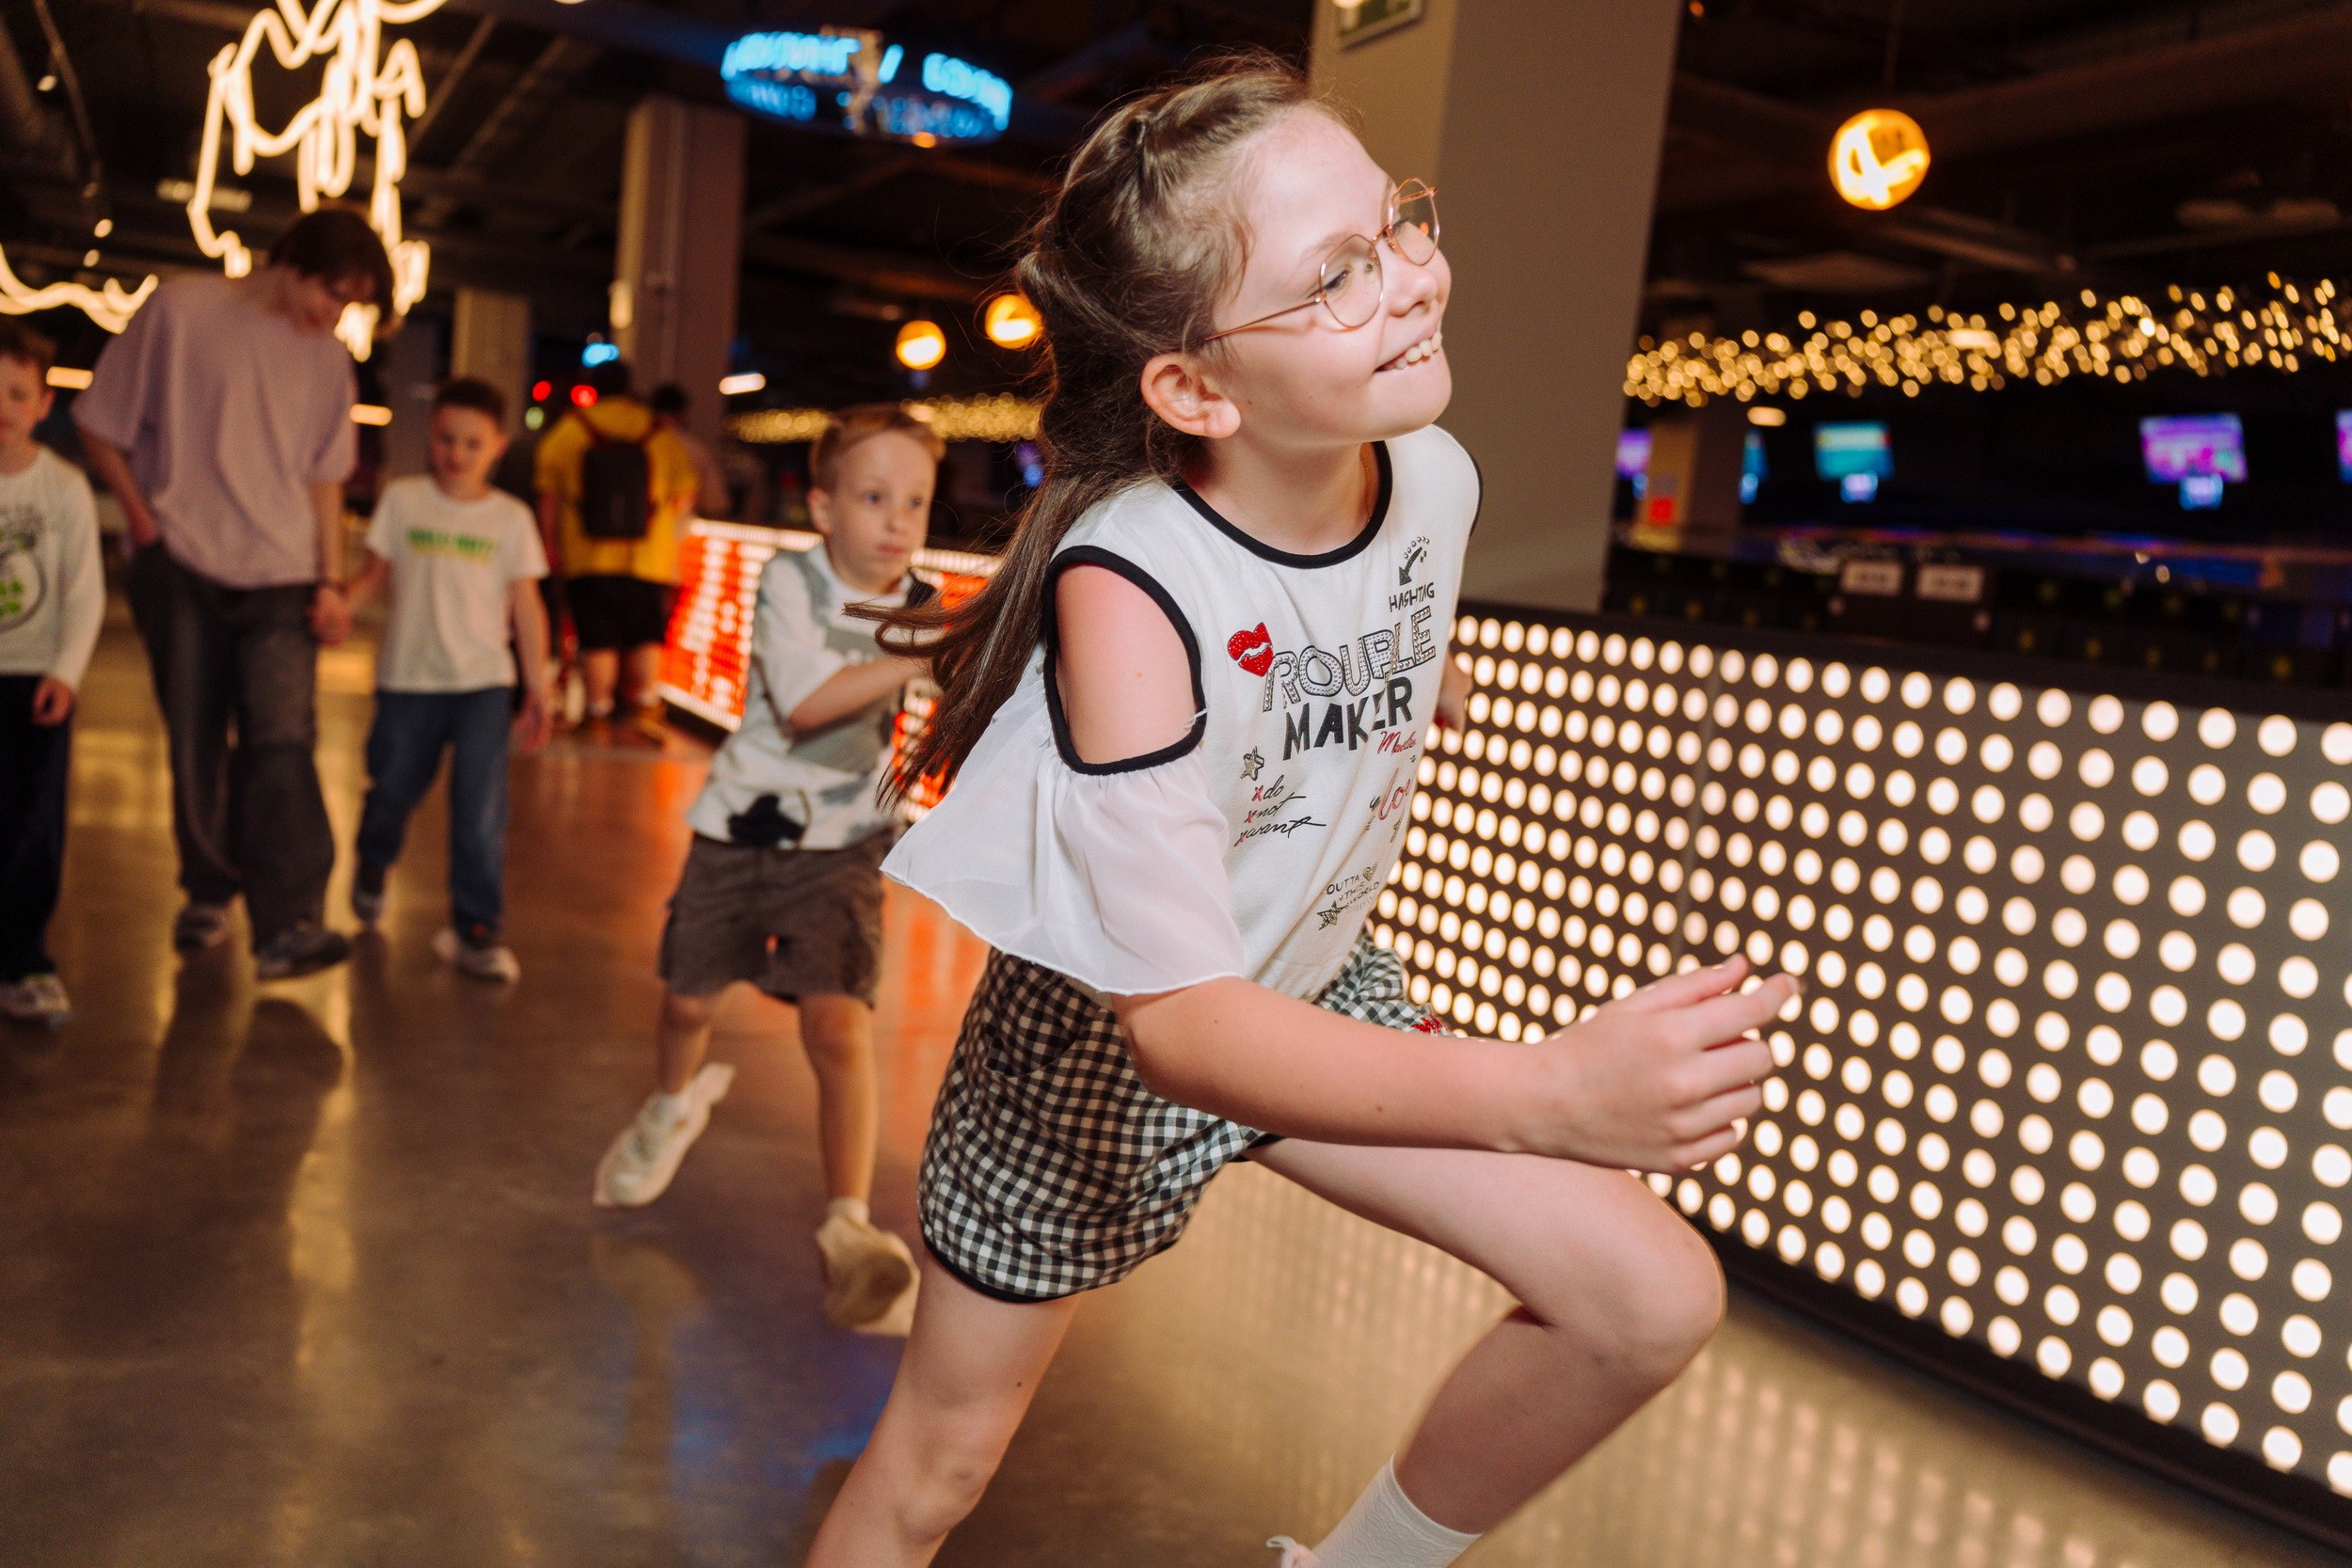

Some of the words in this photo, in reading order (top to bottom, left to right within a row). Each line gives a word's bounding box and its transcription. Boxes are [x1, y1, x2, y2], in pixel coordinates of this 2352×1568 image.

[1389, 581, 1435, 612] HASHTAG
[1283, 676, 1413, 760] MAKER
[1326, 874, 1360, 895] OUTTA
